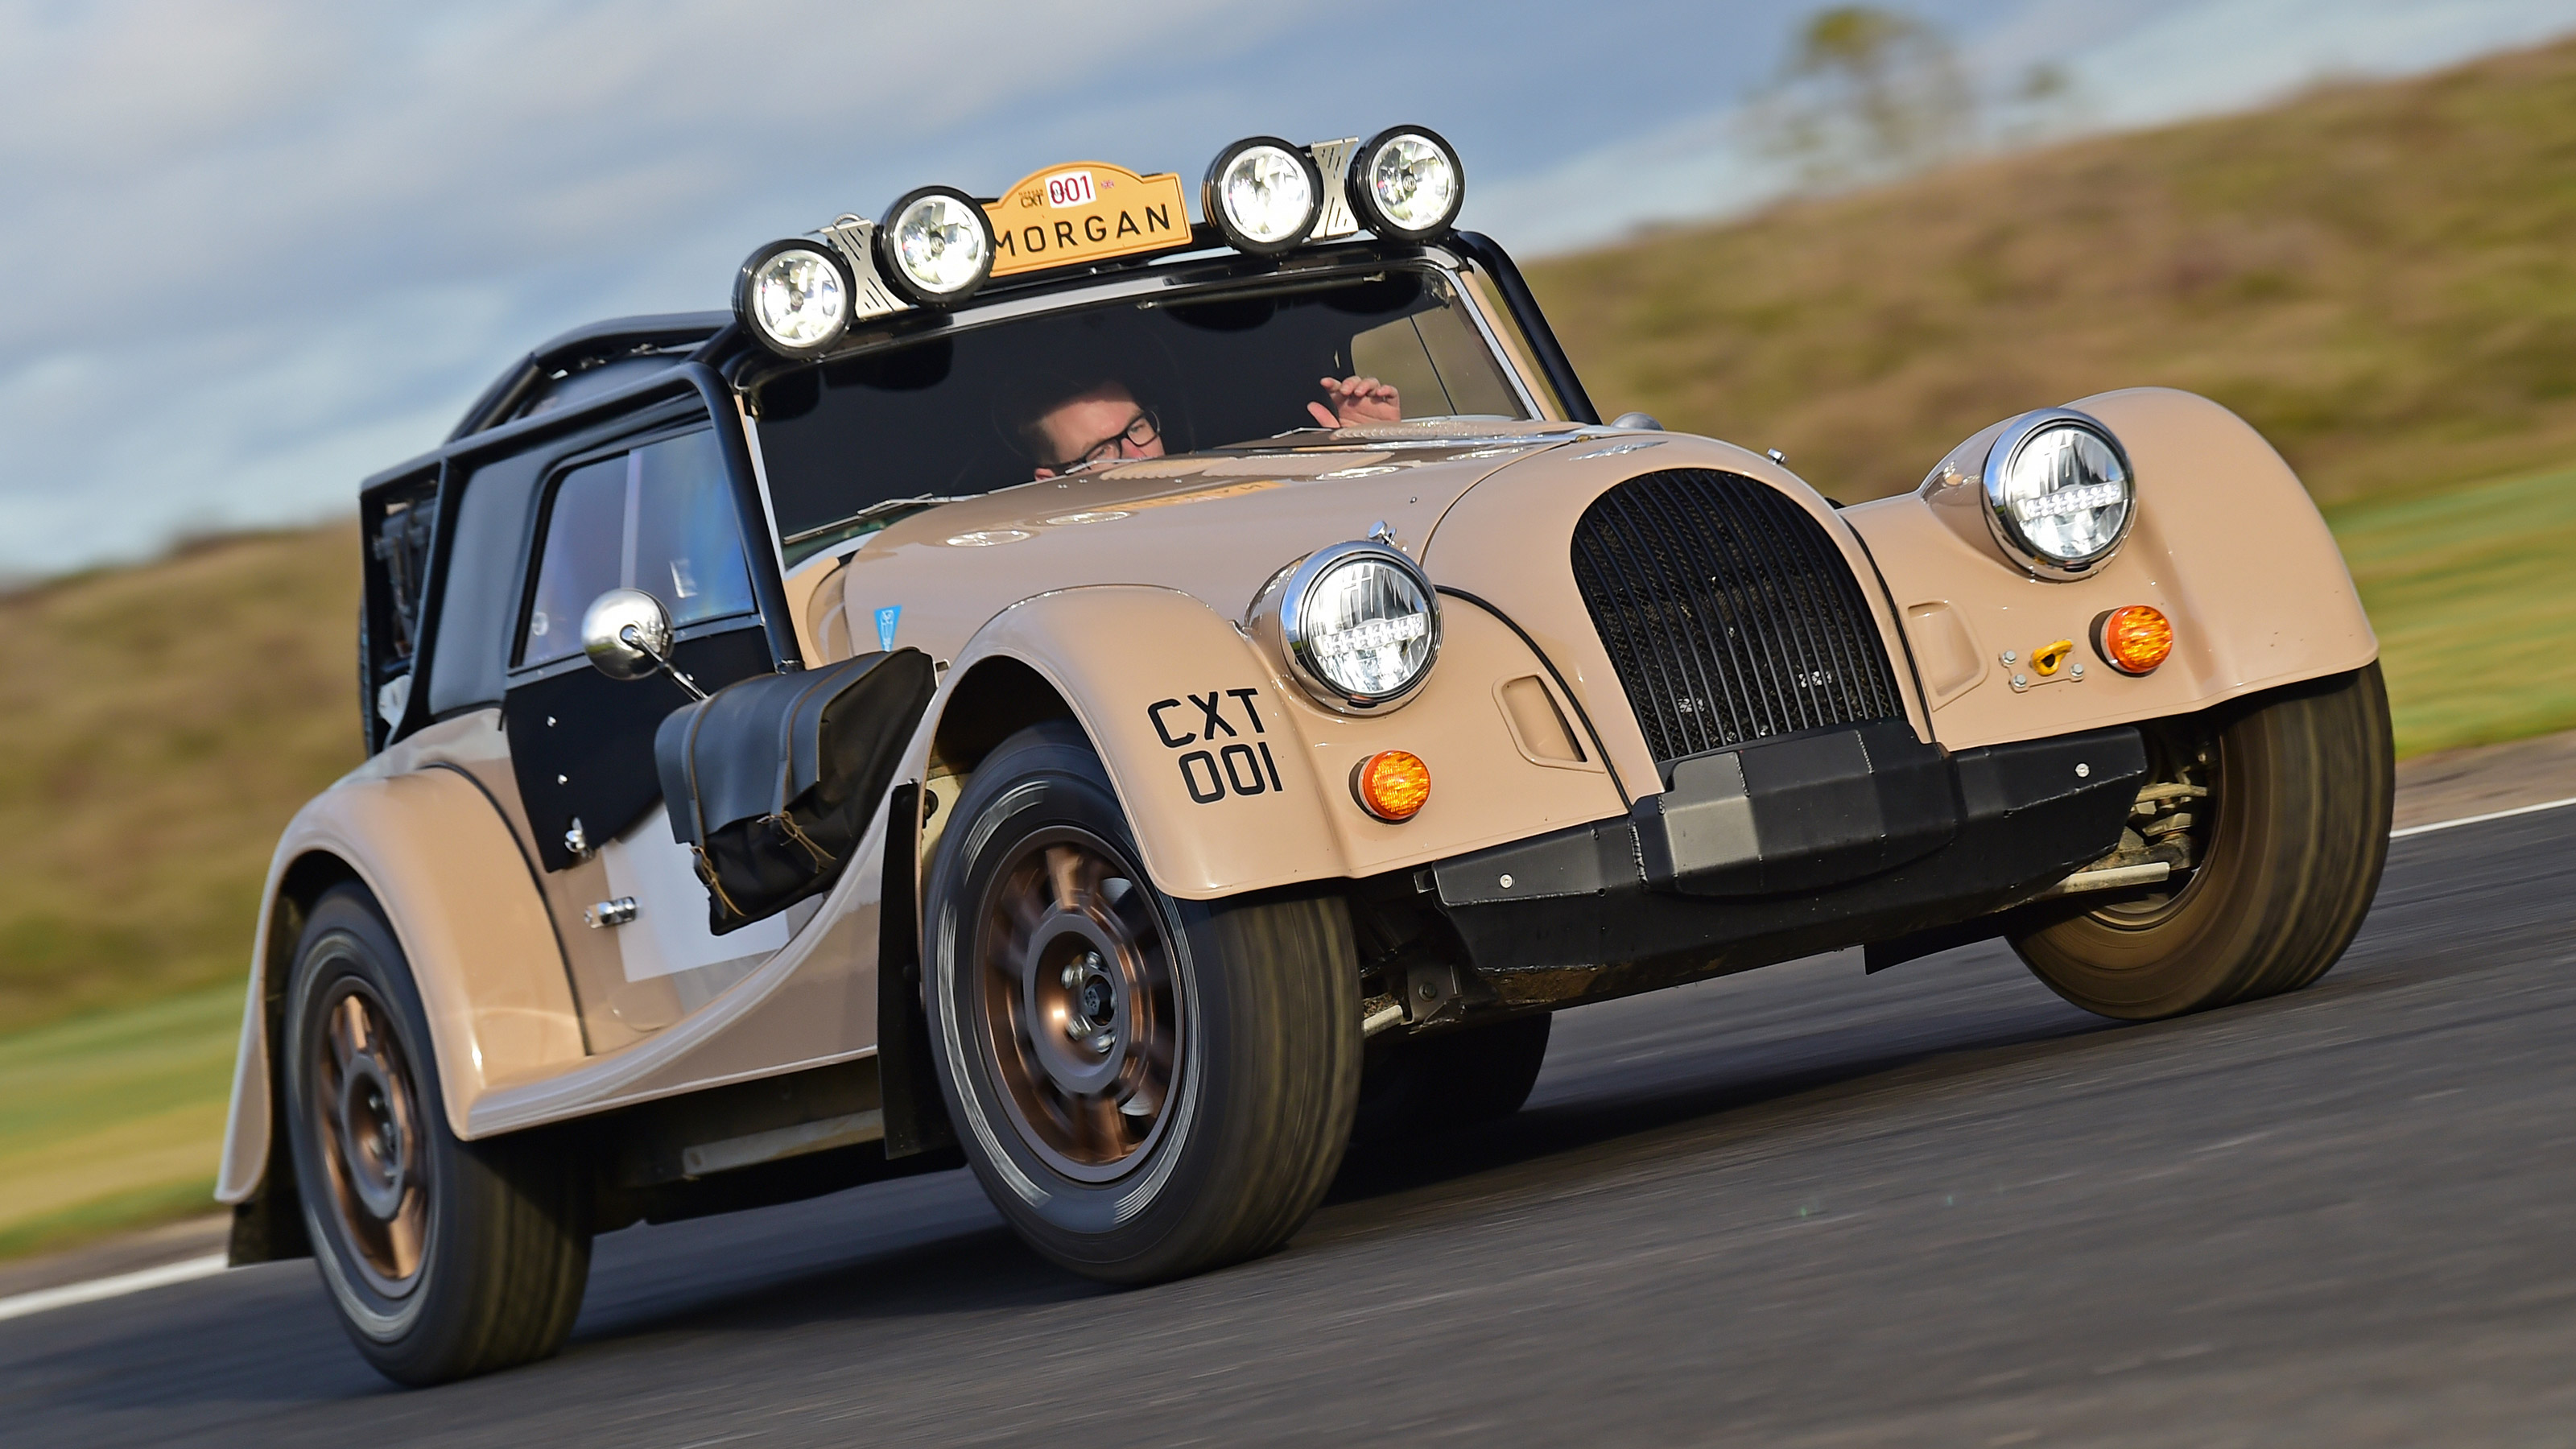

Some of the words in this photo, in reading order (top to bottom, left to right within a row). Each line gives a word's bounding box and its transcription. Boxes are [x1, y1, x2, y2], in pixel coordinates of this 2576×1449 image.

[1021, 194, 1043, 208] CXT
[1050, 175, 1091, 204] 001
[995, 203, 1170, 256] MORGAN
[1147, 688, 1265, 748] CXT
[1179, 741, 1283, 804] 001
